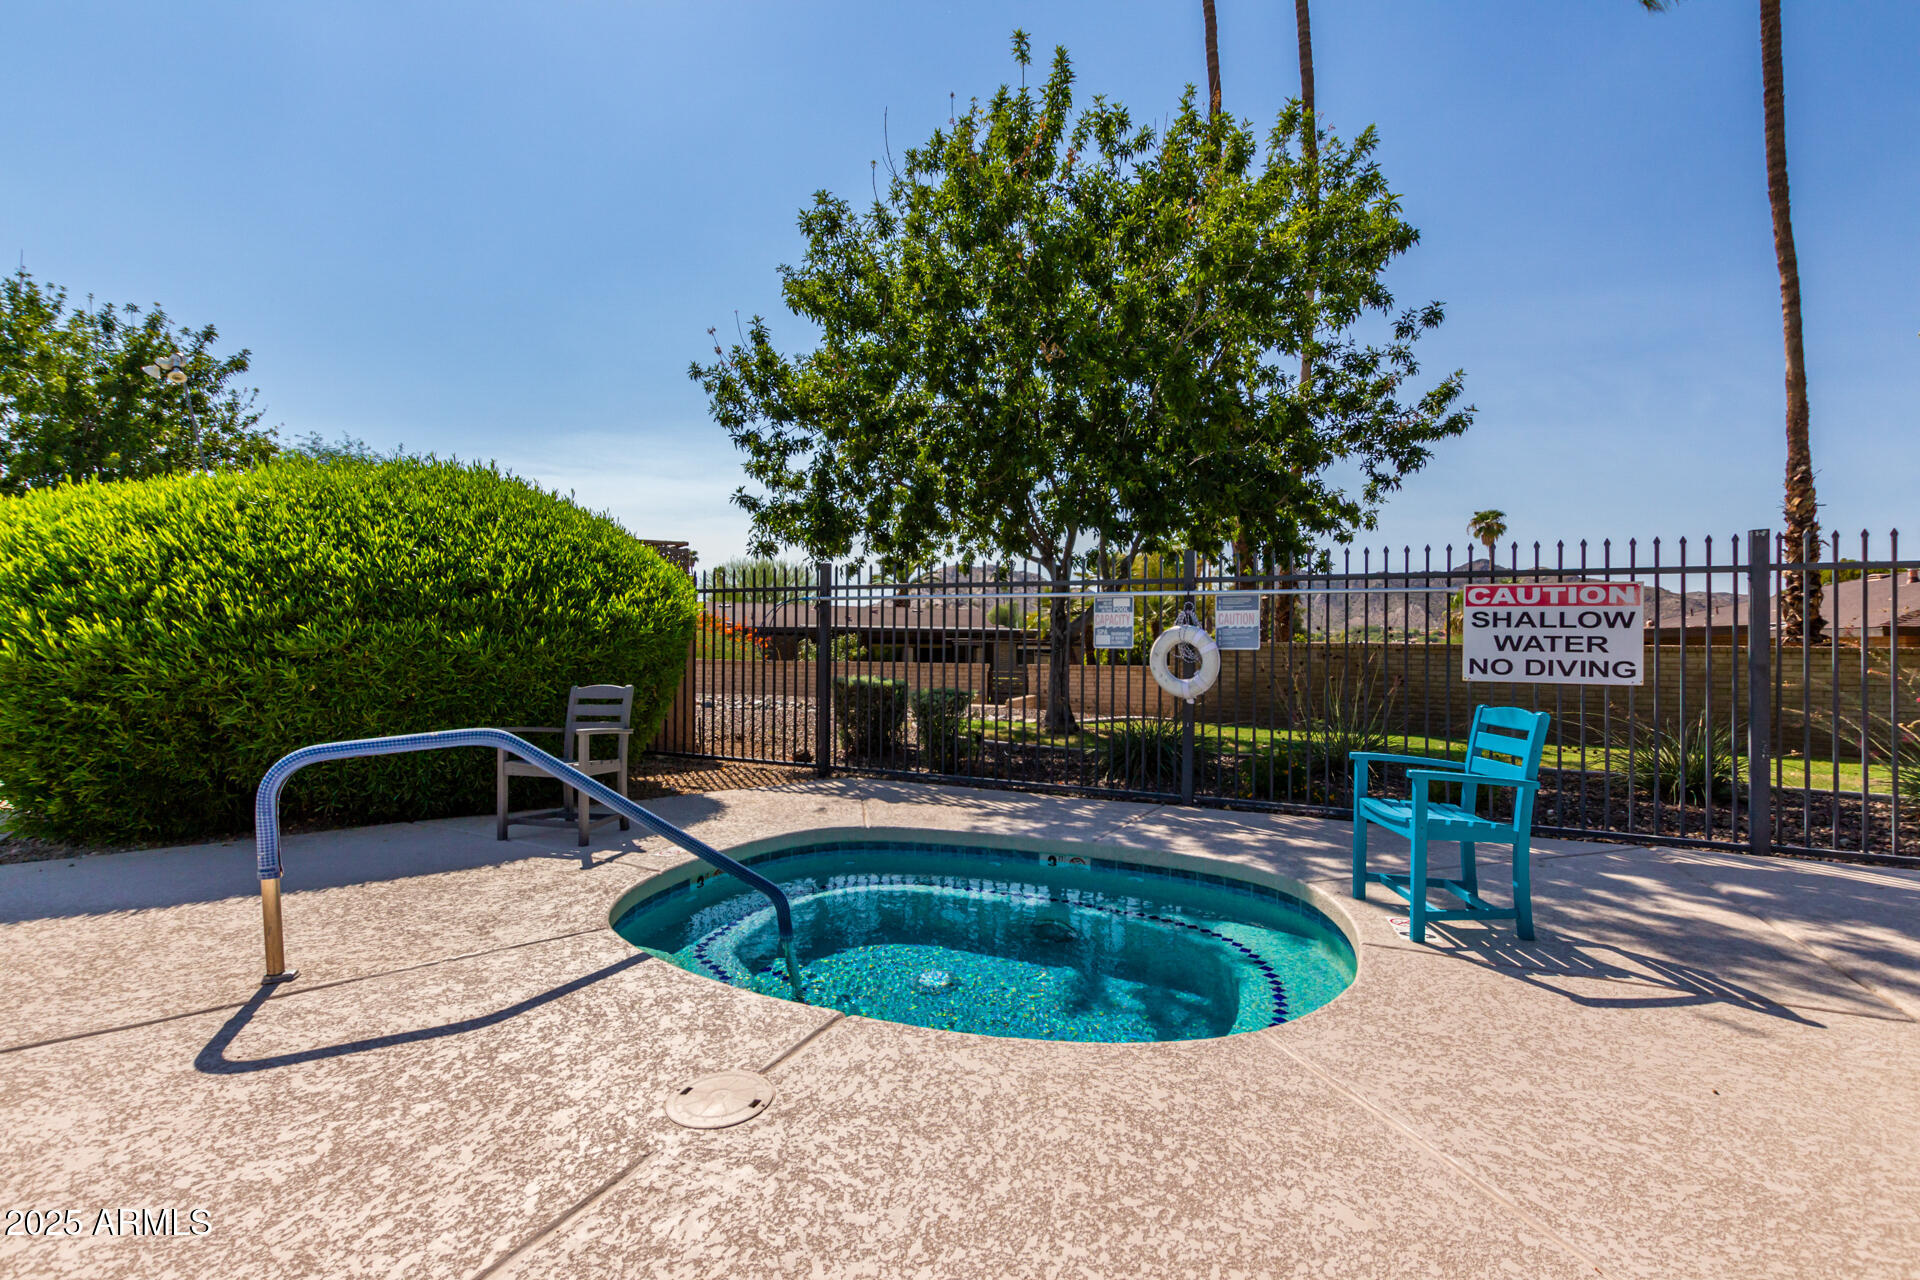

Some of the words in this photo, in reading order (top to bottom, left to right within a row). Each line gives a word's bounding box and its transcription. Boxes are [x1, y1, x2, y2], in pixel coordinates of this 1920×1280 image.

[1467, 586, 1635, 605] CAUTION
[1095, 613, 1131, 626] CAPACITY
[1218, 612, 1255, 625] CAUTION
[1471, 611, 1635, 629] SHALLOW
[1494, 635, 1609, 653] WATER
[1469, 658, 1513, 676] NO
[1525, 659, 1636, 679] DIVING
